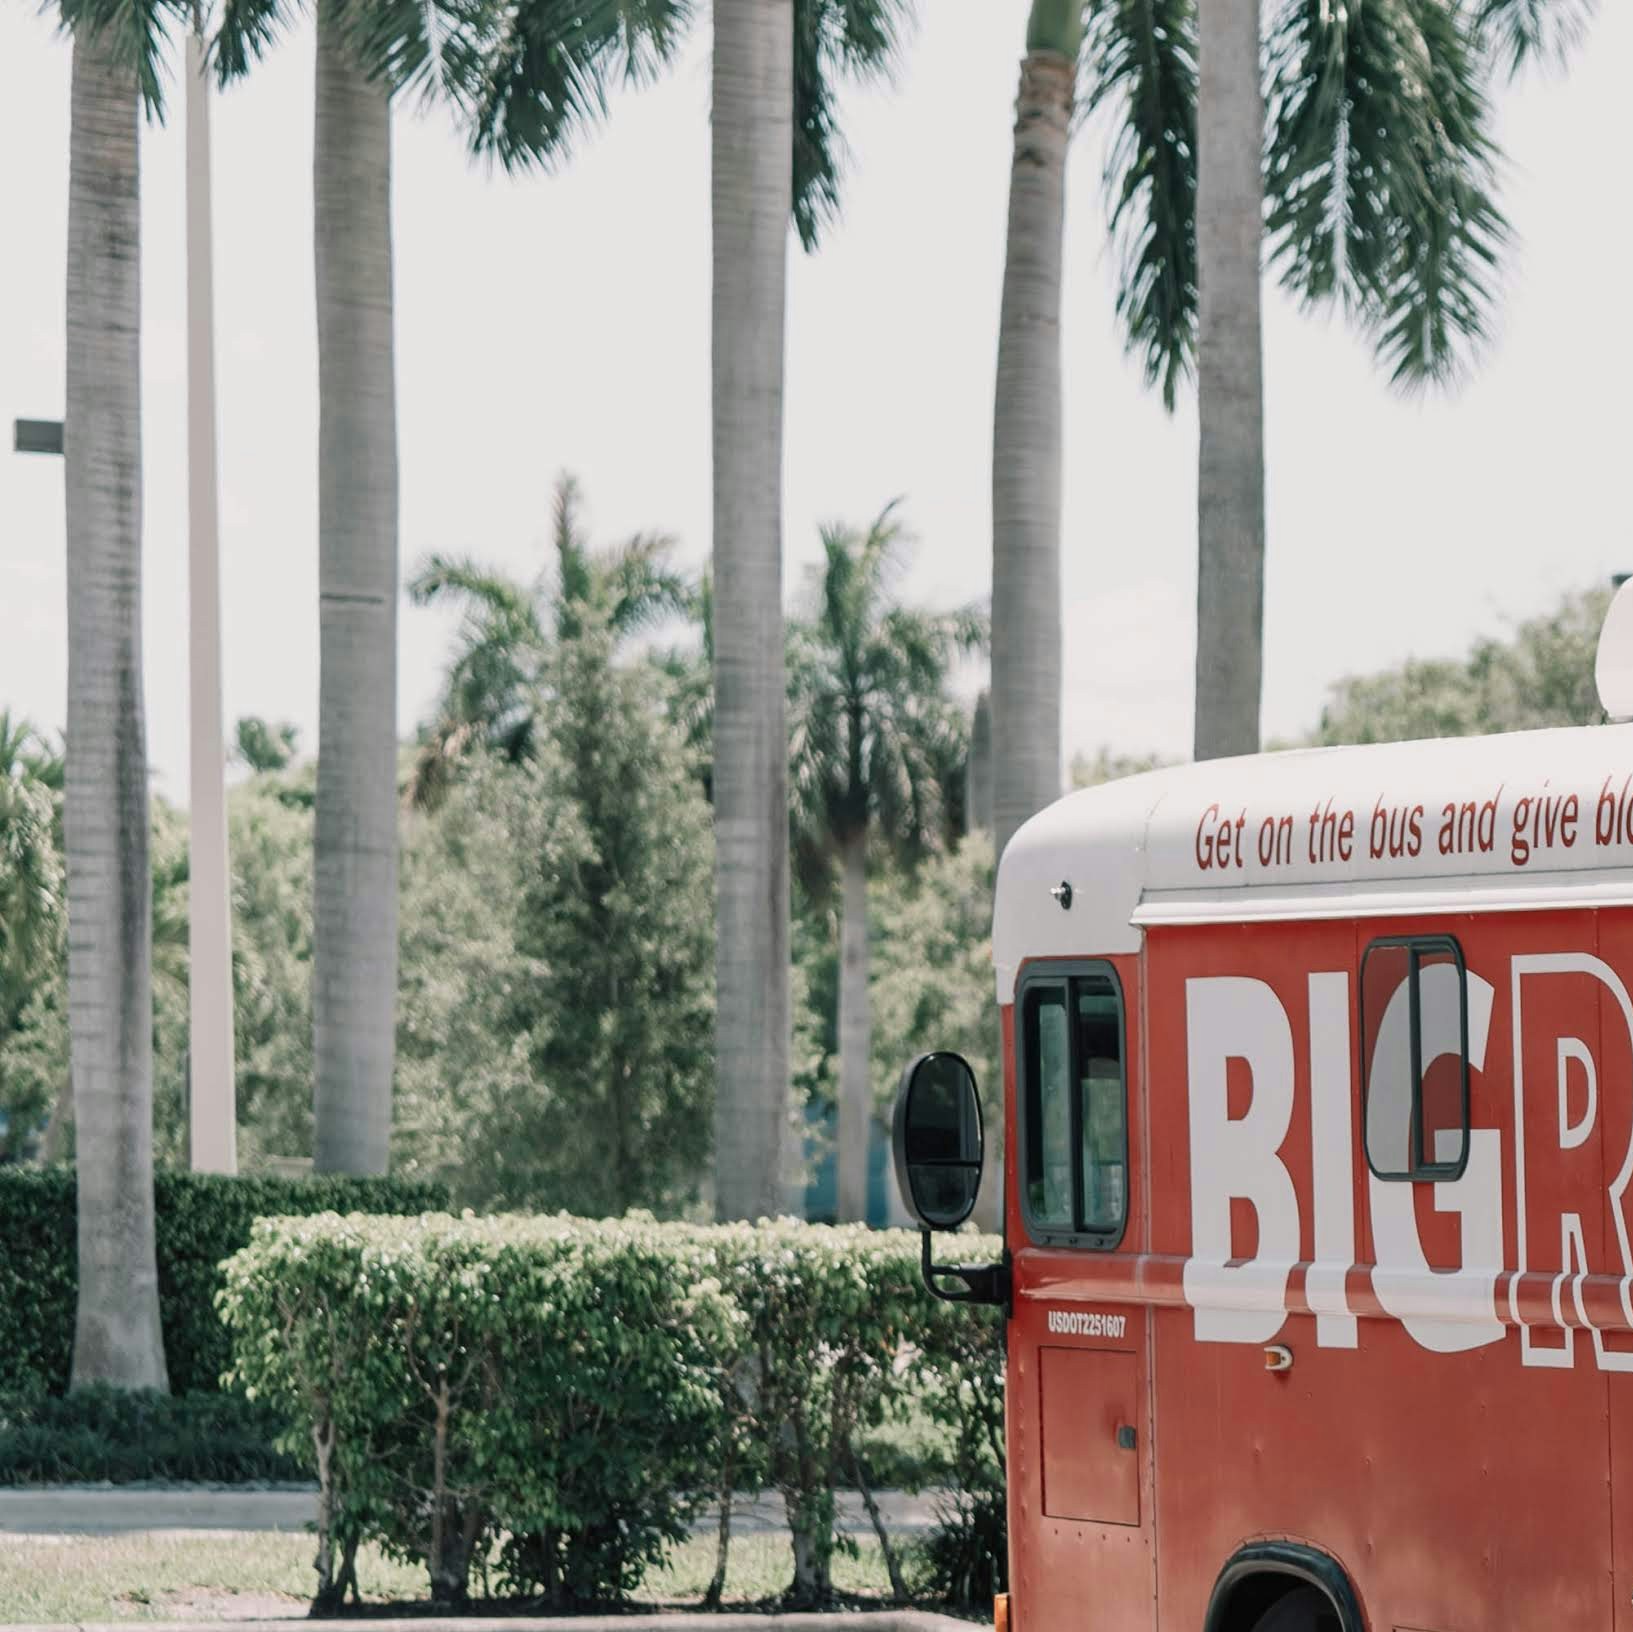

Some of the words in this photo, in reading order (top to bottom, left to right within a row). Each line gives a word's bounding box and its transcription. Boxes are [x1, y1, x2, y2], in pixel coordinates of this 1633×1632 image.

[1195, 802, 1247, 871] Get
[1258, 814, 1294, 867] on
[1308, 794, 1355, 864] the
[1370, 791, 1424, 860] bus
[1438, 783, 1505, 856] and
[1511, 778, 1579, 867] give
[1182, 960, 1507, 1353] BIG
